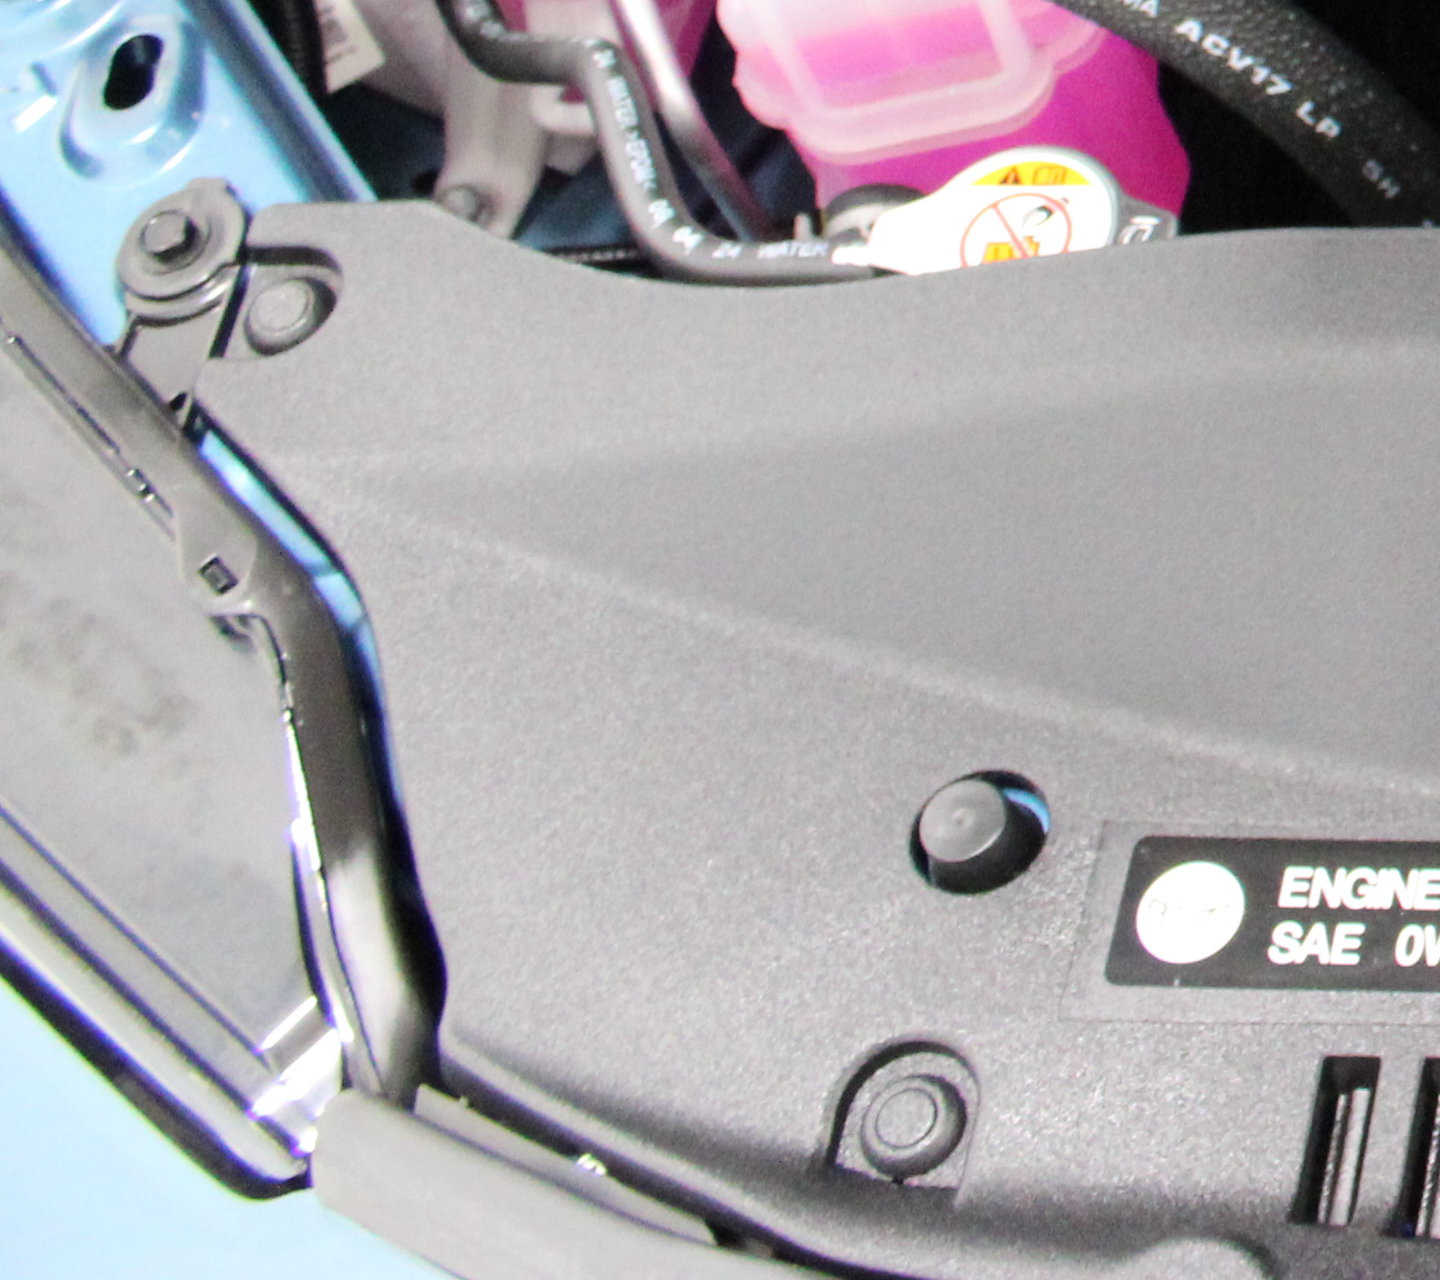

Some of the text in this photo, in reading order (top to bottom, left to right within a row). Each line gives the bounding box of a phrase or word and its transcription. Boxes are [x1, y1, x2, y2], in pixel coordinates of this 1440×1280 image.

[1174, 17, 1294, 98] ACV17
[1296, 100, 1343, 141] LP
[756, 241, 830, 259] WATER
[1266, 920, 1367, 966] SAE
